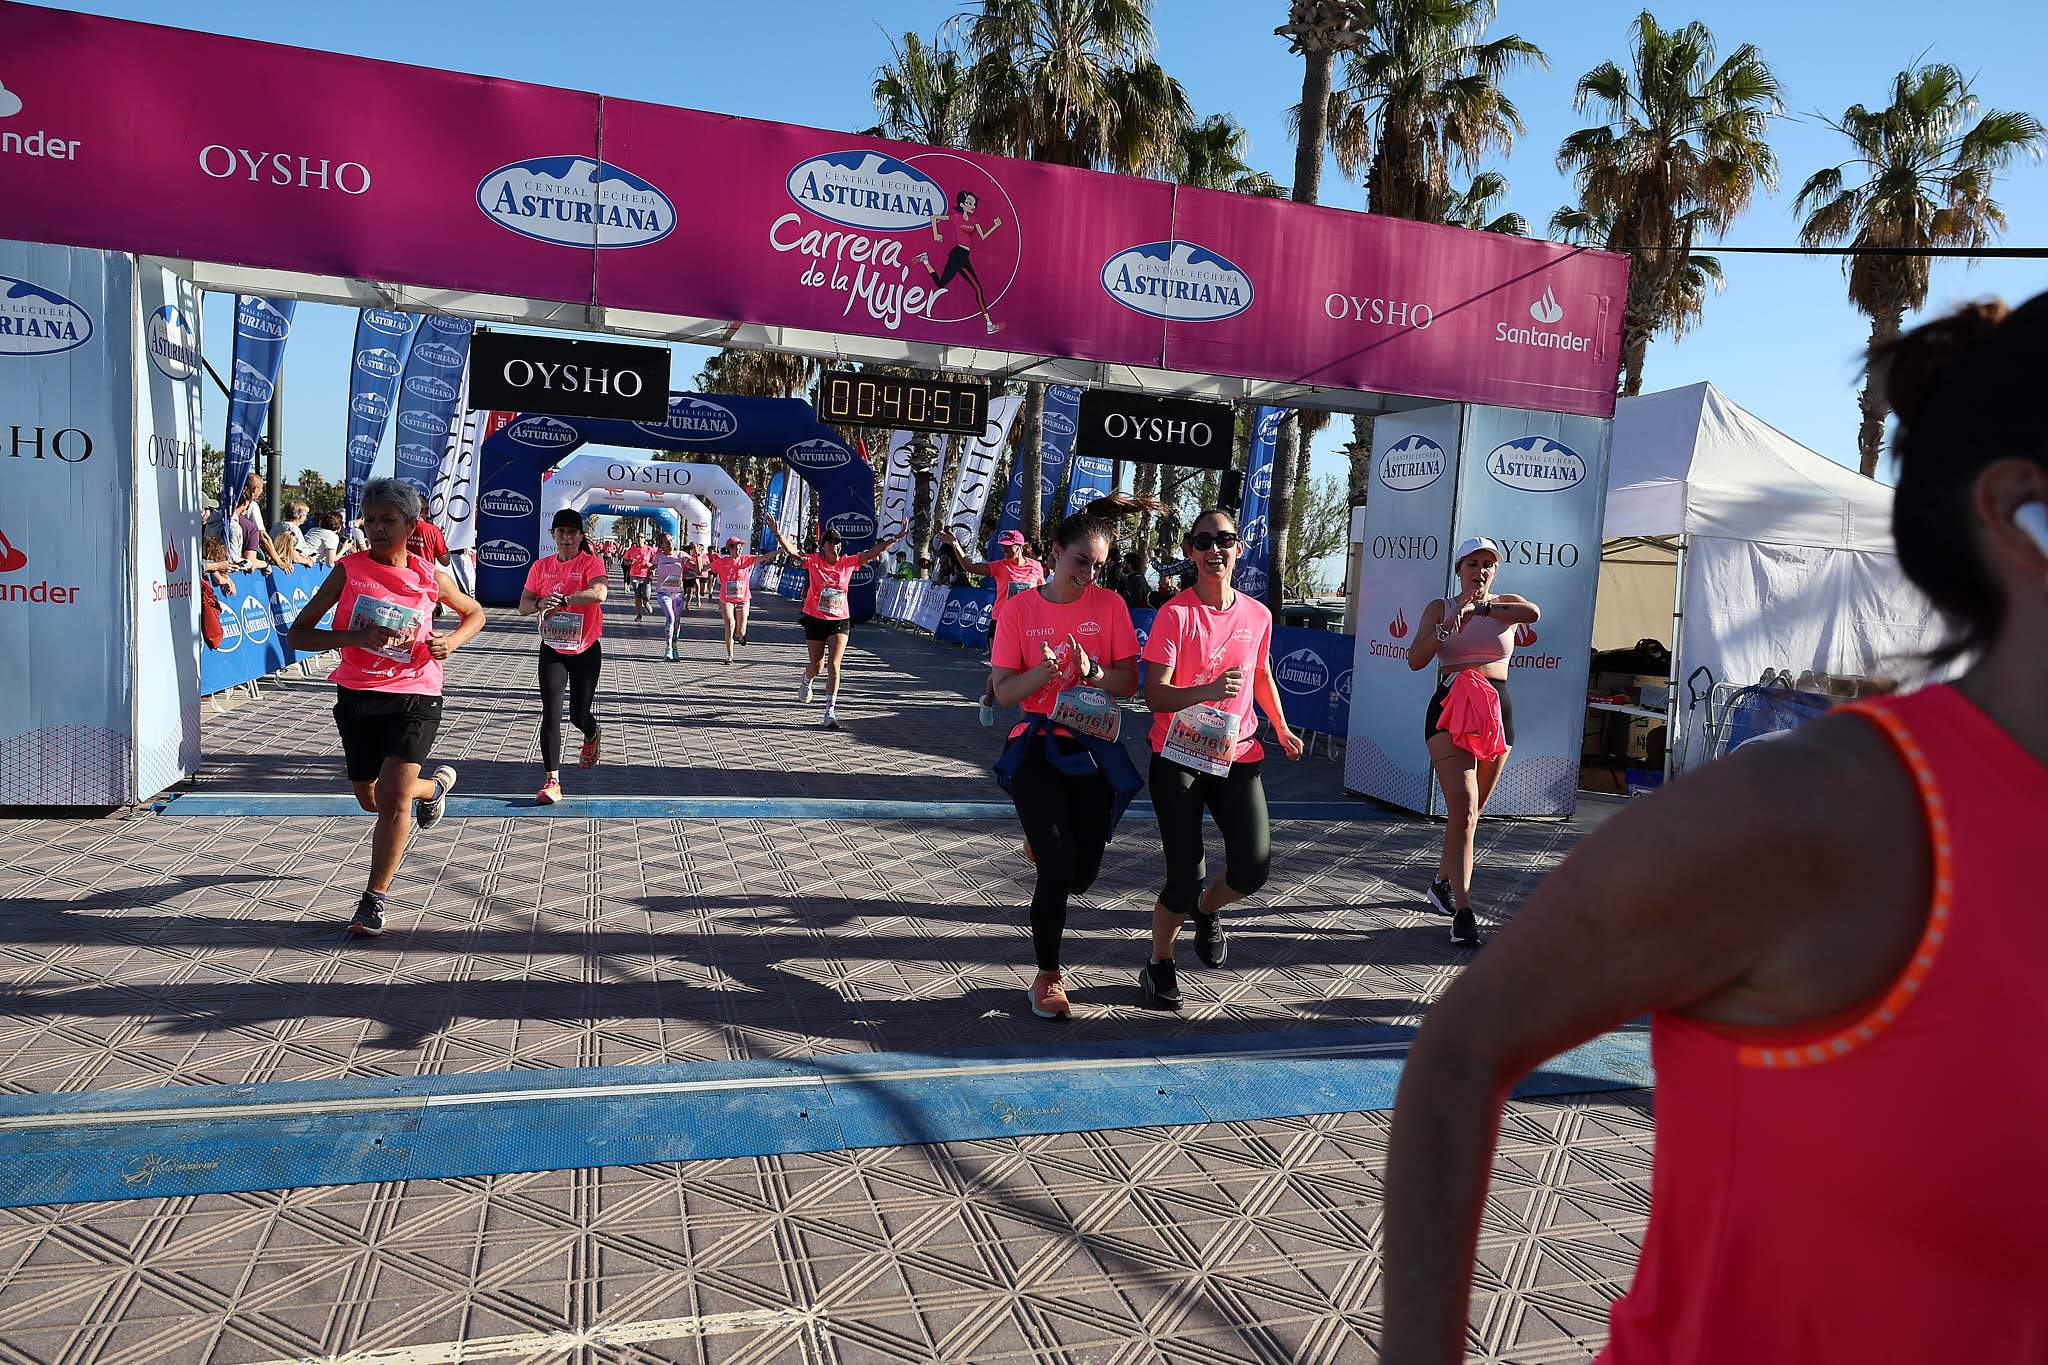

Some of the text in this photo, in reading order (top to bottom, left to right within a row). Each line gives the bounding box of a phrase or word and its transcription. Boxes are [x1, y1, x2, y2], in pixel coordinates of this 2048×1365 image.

[199, 143, 371, 195] OYSHO
[524, 181, 588, 197] CENTRAL
[799, 170, 934, 217] ASTURIANA
[825, 172, 932, 194] CENTRAL LECHERA
[492, 180, 662, 232] ASTURIANA
[769, 213, 903, 268] Carrera
[1138, 263, 1239, 284] CENTRAL LECHERA
[800, 260, 948, 330] de la Mujer
[1113, 263, 1242, 307] ASTURIANA
[13, 304, 73, 318] LECHERA
[1325, 293, 1433, 330] OYSHO
[1495, 322, 1591, 352] Santander
[418, 346, 460, 365] ASTURIANA
[410, 378, 452, 398] ASTURIANA
[503, 359, 643, 398] OYSHO
[831, 380, 976, 425] 00:40:57
[402, 413, 445, 433] ASTURIANA
[512, 426, 572, 442] ASTURIANA
[639, 416, 730, 433] TURIANA
[1104, 413, 1212, 448] OYSHO
[148, 434, 196, 473] OYSHO
[792, 451, 847, 462] ASTURIANA
[607, 463, 692, 486] OYSHO
[1382, 458, 1440, 479] ASTURIANA
[1493, 453, 1579, 482] ASTURIANA
[554, 479, 582, 487] OYSHO
[714, 488, 739, 496] OYSHO
[482, 500, 530, 513] ASTURIANA
[479, 550, 527, 563] ASTURIANA
[1373, 535, 1438, 560] OYSHO
[152, 580, 192, 602] Santander
[1025, 627, 1055, 637] OYSHO
[1369, 639, 1410, 660] Santan
[1278, 665, 1323, 688] ASTURIANA
